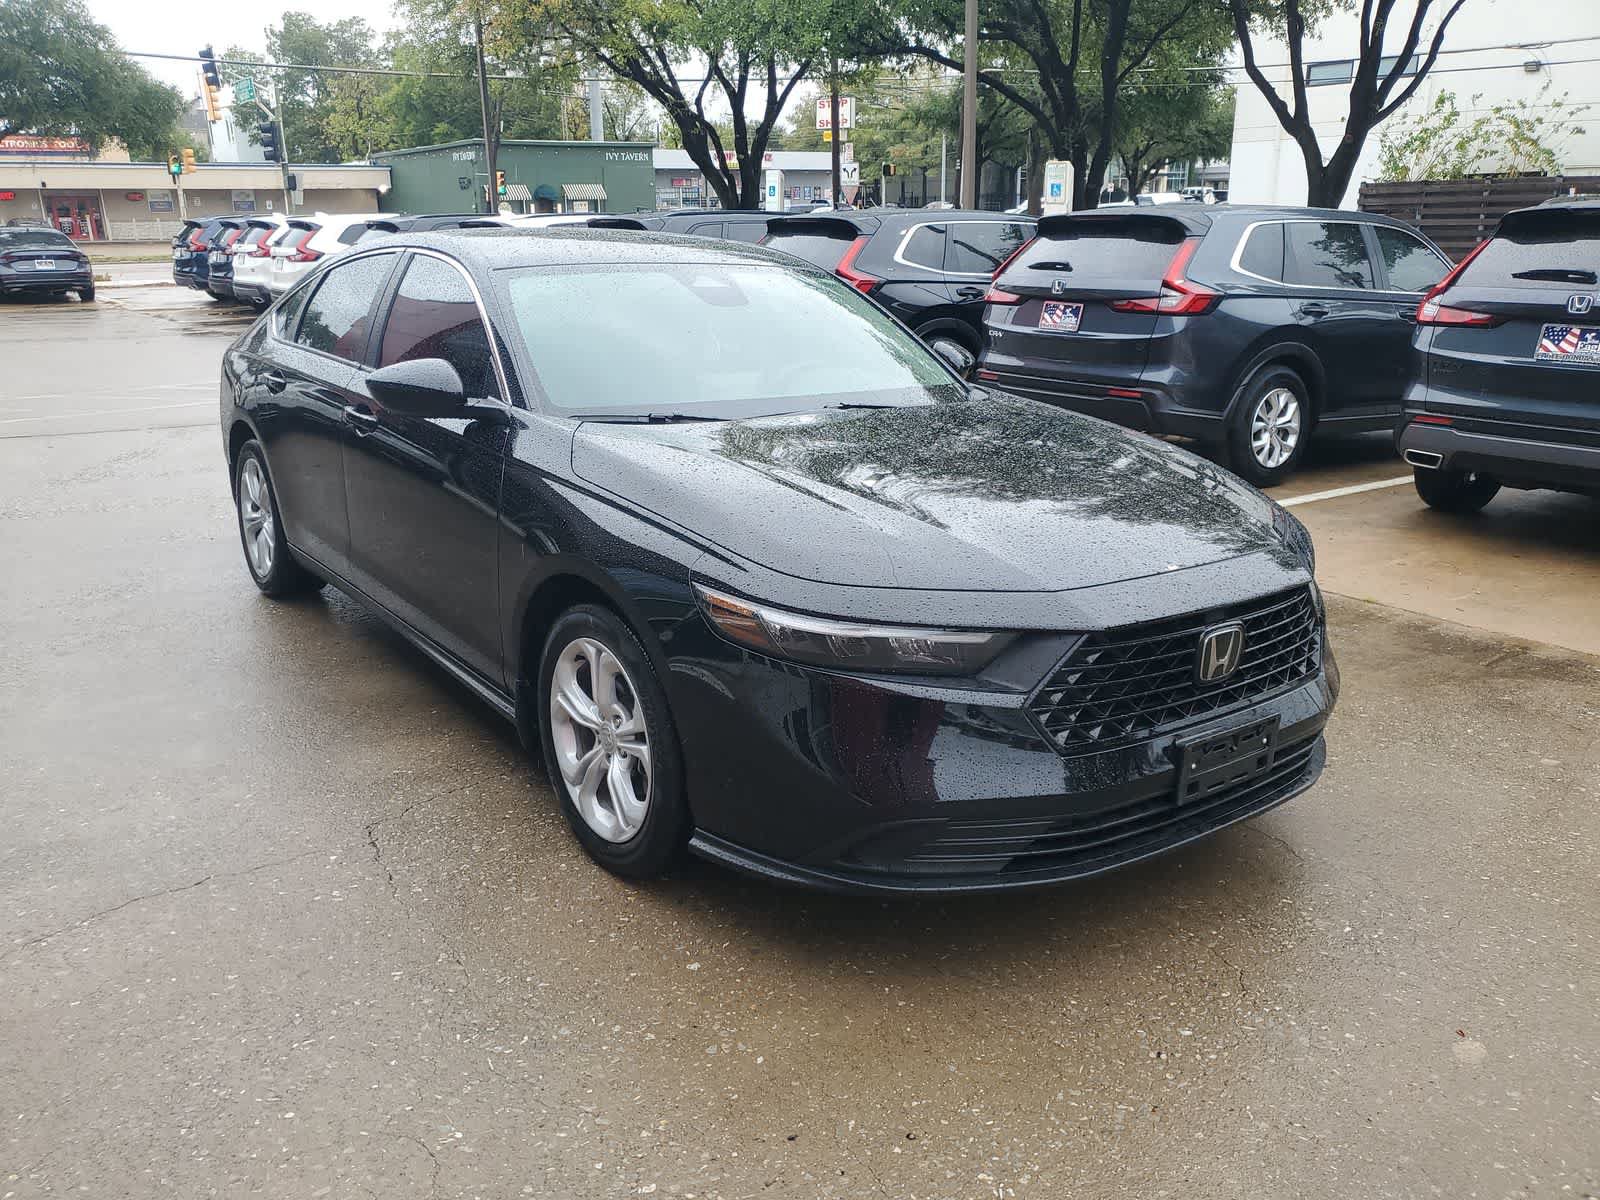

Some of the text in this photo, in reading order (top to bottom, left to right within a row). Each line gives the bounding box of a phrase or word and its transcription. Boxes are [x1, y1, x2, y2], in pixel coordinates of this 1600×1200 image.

[818, 98, 848, 109] STP
[818, 119, 848, 128] SHP
[605, 152, 649, 161] IVY TAVERN
